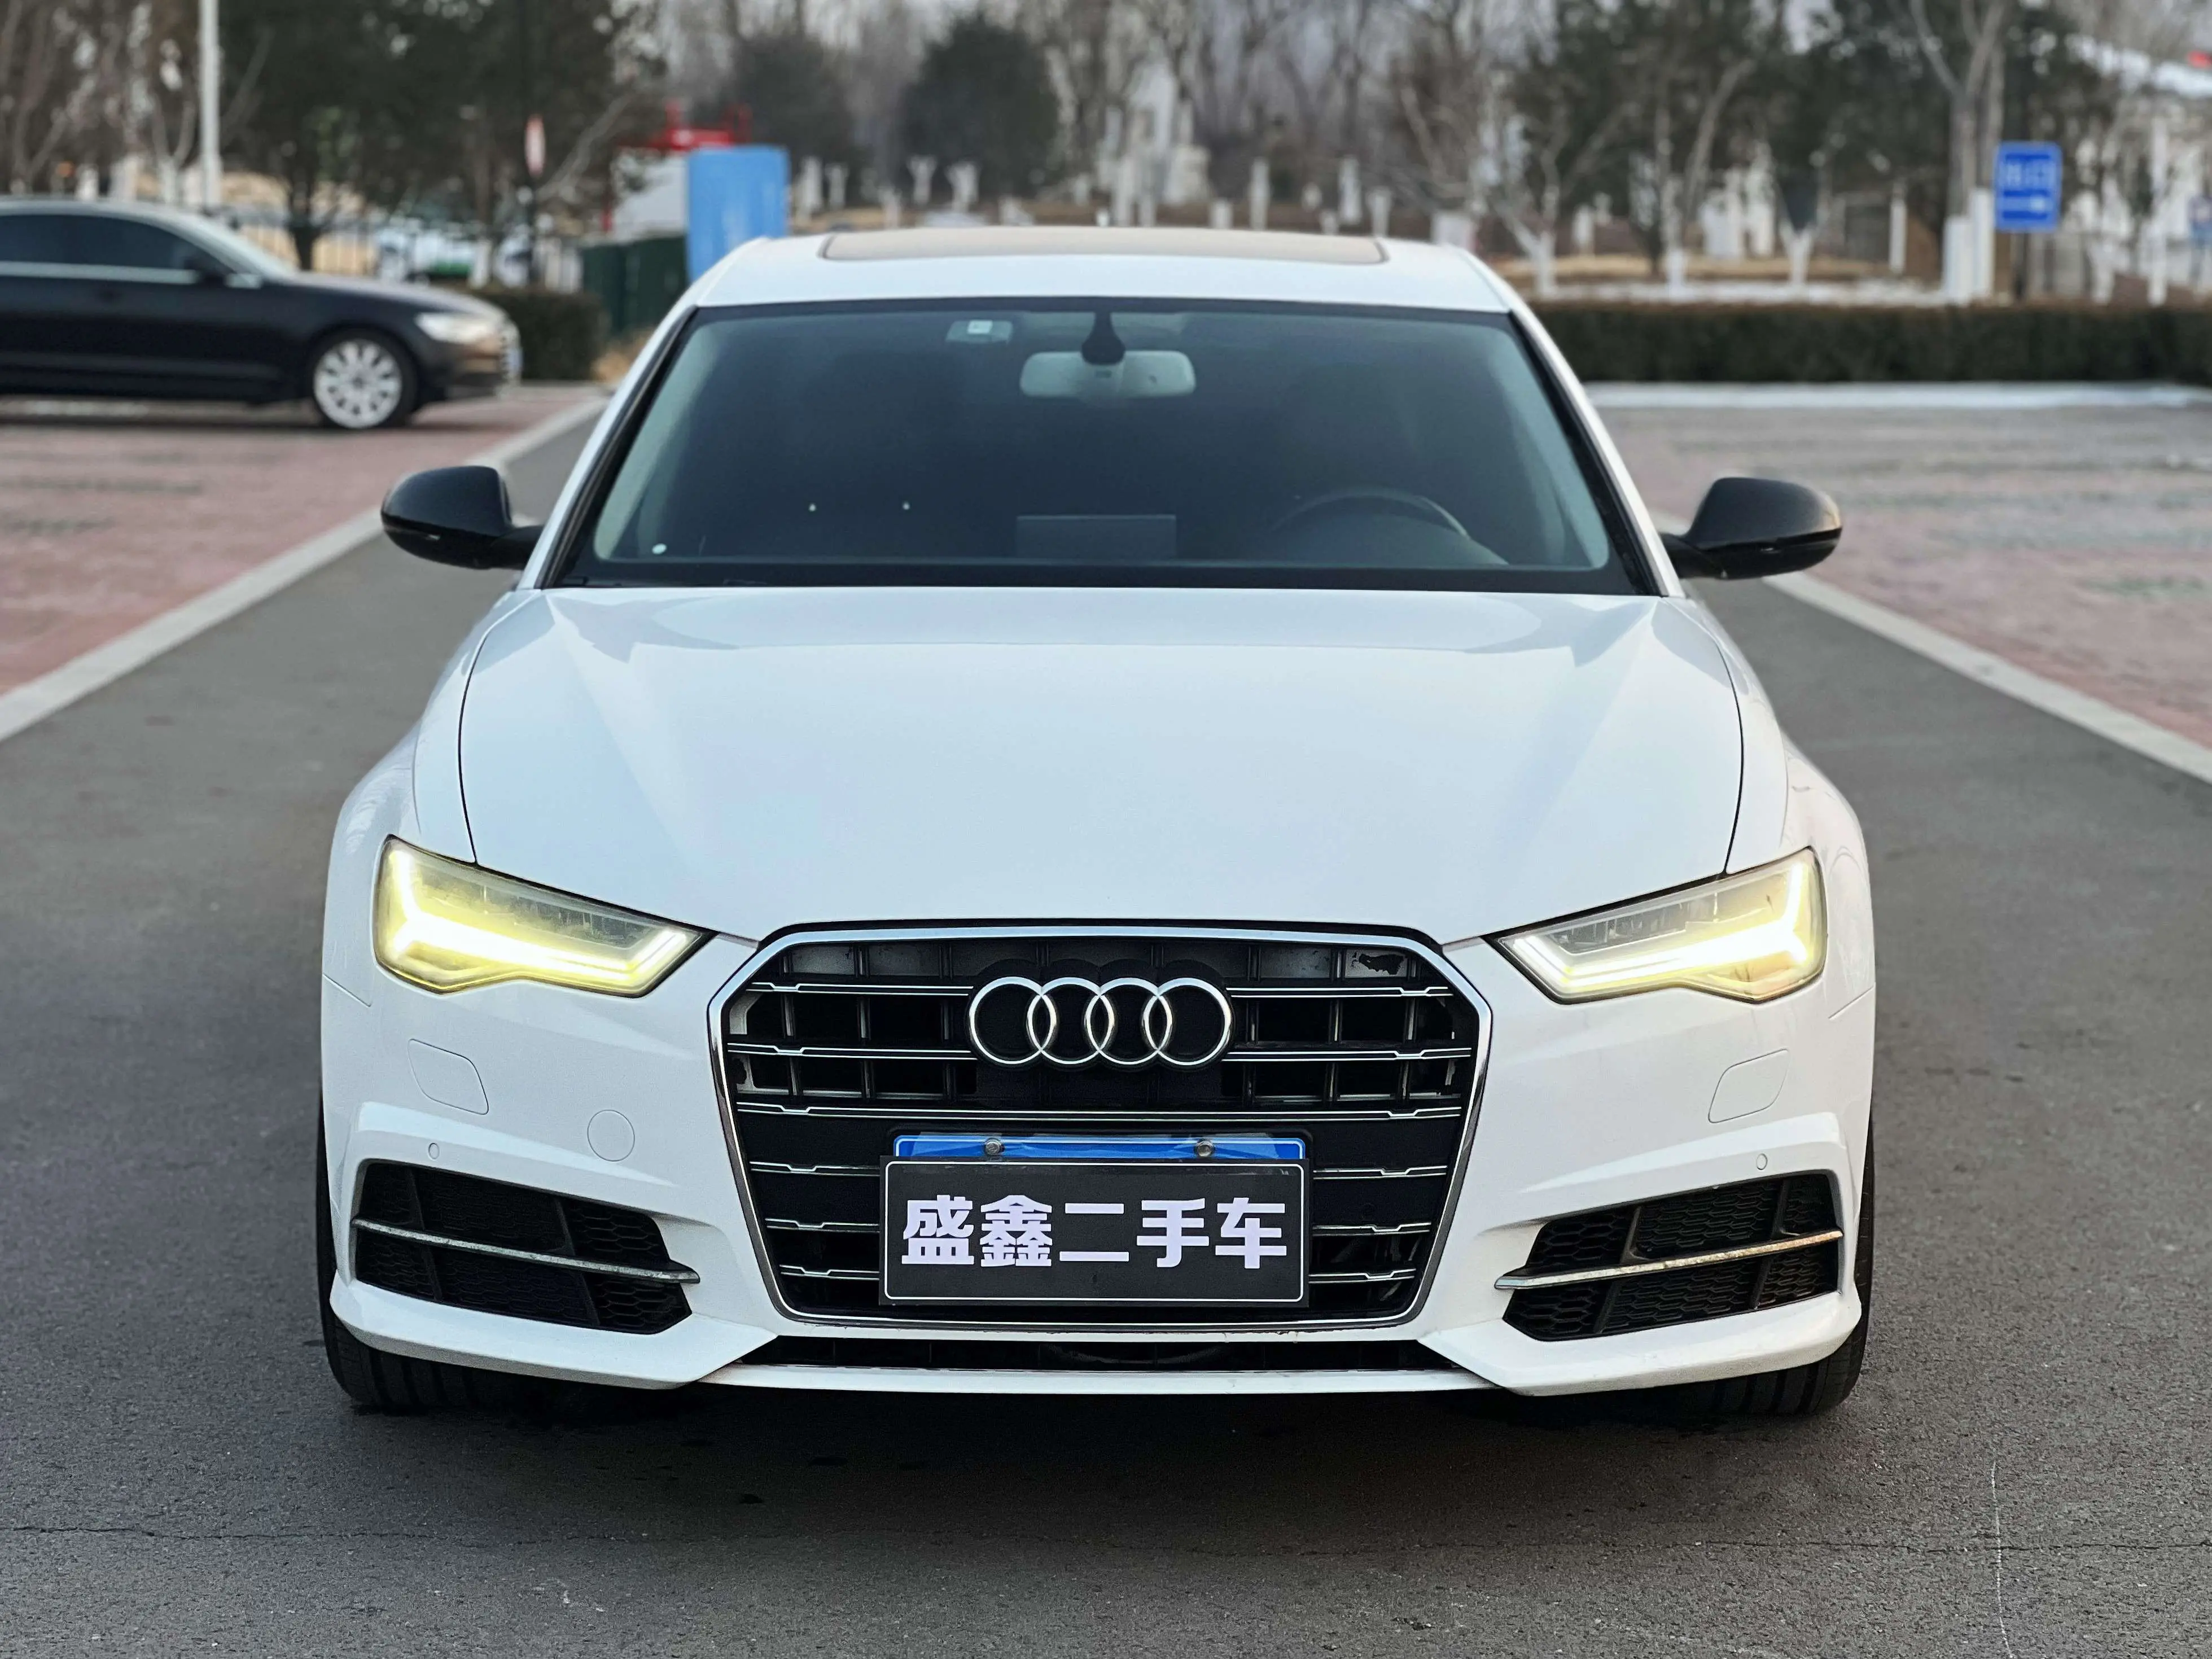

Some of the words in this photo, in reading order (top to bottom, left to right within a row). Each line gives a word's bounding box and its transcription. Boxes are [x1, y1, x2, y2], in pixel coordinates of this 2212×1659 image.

[901, 1194, 1287, 1269] 盛鑫二手车
